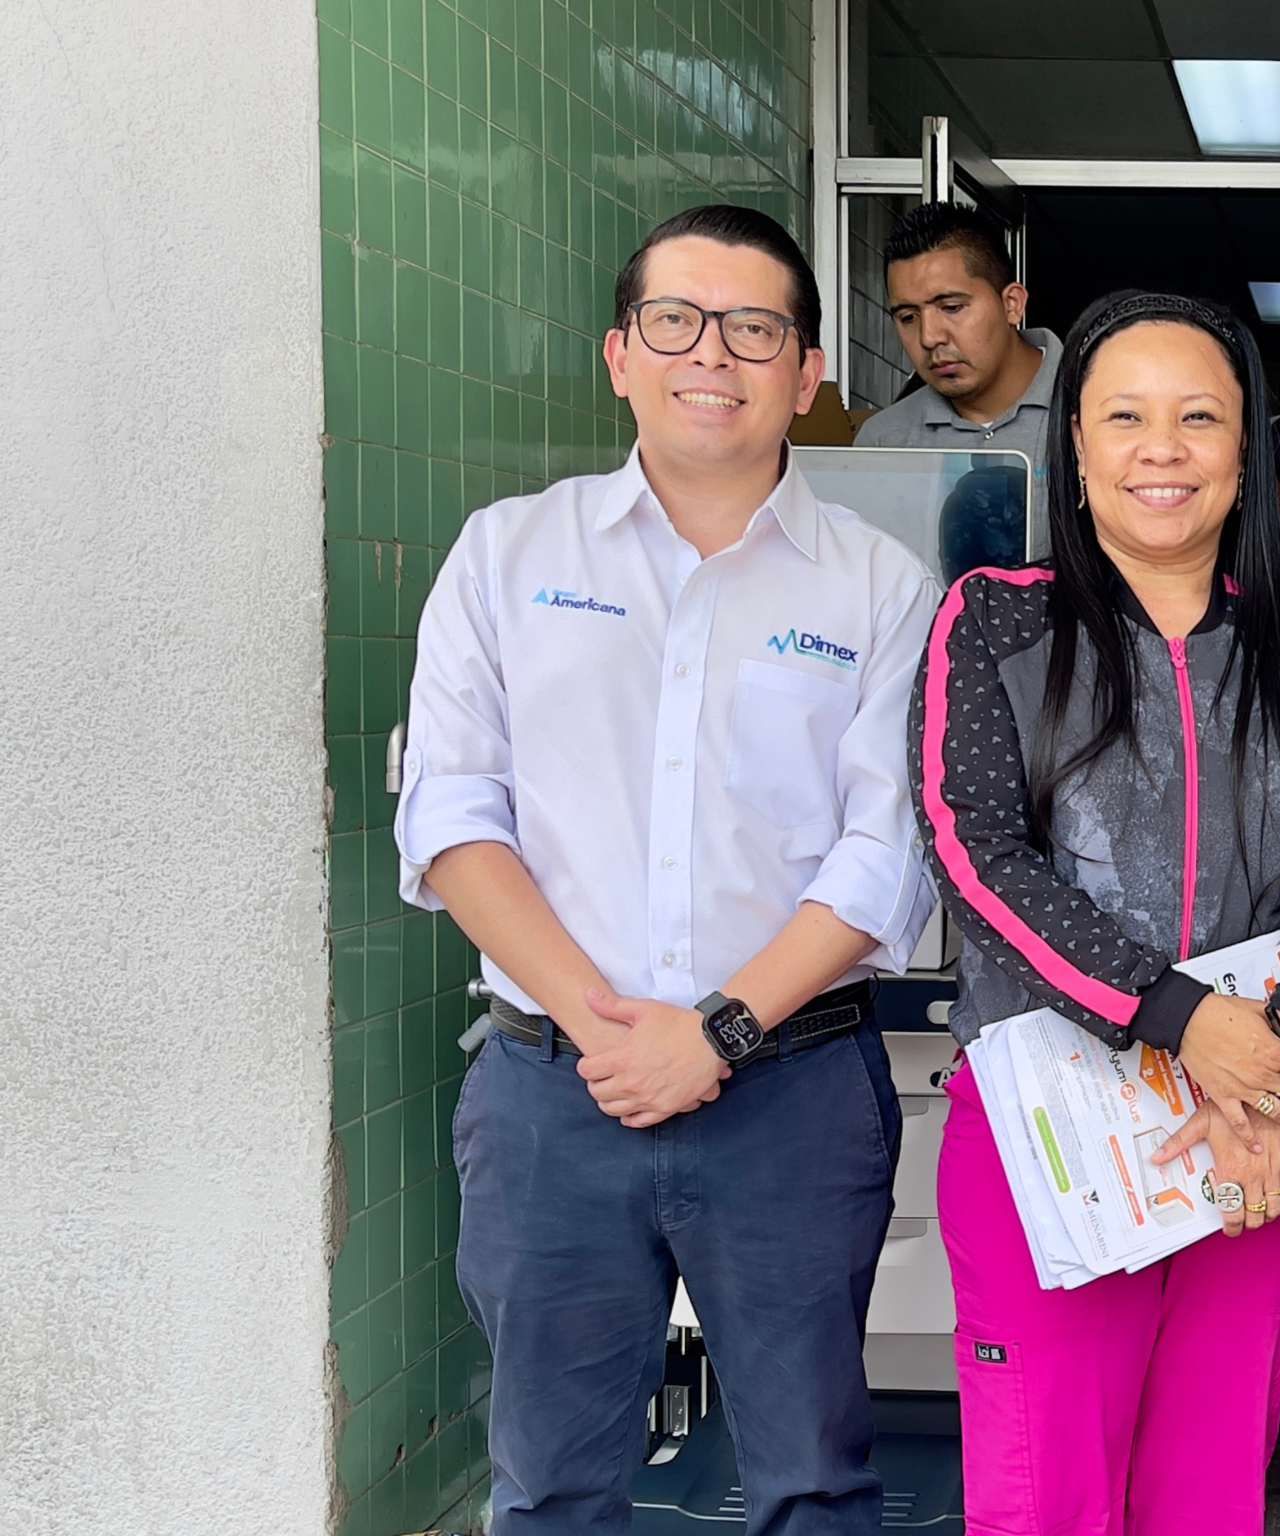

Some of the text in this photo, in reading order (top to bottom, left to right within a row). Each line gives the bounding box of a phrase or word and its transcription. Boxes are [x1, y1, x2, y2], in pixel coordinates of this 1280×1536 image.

[550, 594, 626, 617] Americana
[799, 632, 859, 663] Dimex
[1067, 1049, 1082, 1063] 1
[1140, 1065, 1155, 1079] 2
[1086, 1208, 1110, 1259] MENARINI
